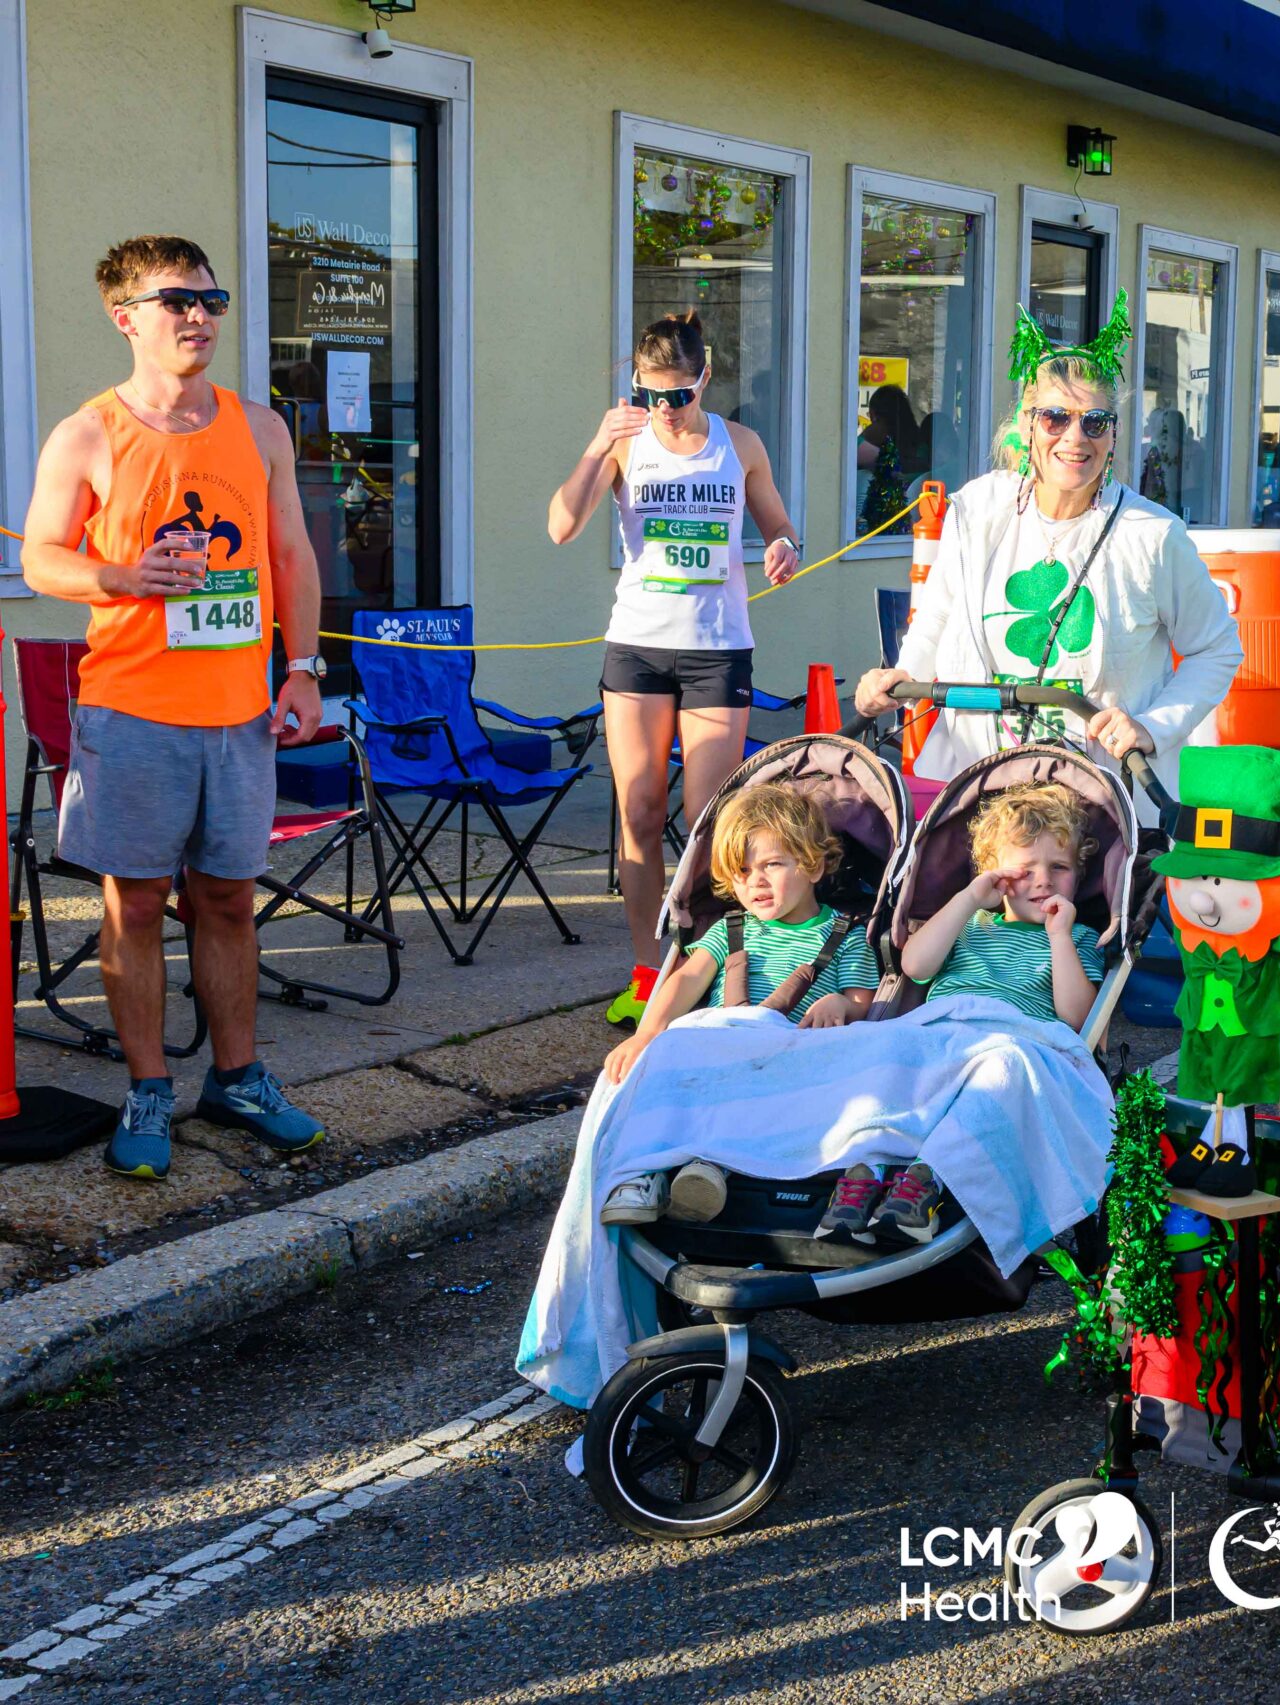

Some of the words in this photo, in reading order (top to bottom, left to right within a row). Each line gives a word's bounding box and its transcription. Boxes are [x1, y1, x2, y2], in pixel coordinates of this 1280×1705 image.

[296, 217, 312, 239] US
[318, 220, 349, 242] Wall
[312, 256, 328, 268] 3210
[330, 258, 360, 271] Metairie
[361, 262, 381, 272] Road
[330, 273, 350, 283] SUITE
[311, 332, 385, 346] USWALLDECOR.COM
[634, 483, 686, 504] POWER
[692, 483, 736, 505] MILER
[664, 504, 687, 515] TRACK
[689, 504, 708, 515] CLUB
[144, 471, 199, 509] LOUISIANA
[202, 472, 250, 512] RUNNING
[249, 517, 258, 569] WALKIN
[665, 544, 711, 569] 690
[185, 599, 254, 631] 1448
[776, 1191, 811, 1201] THULE
